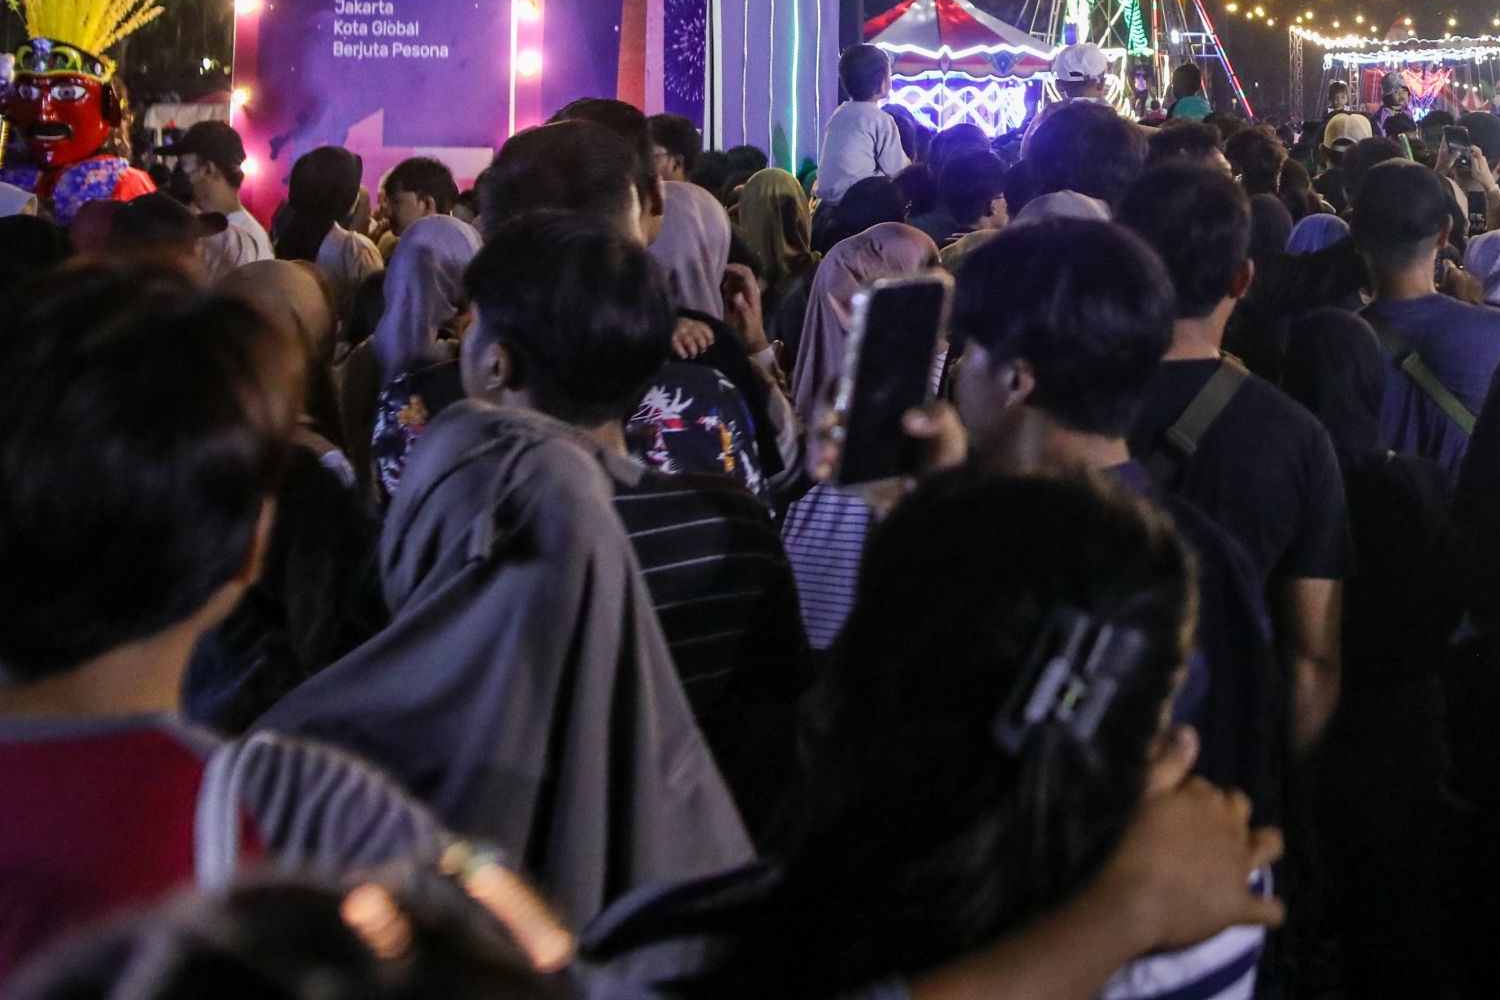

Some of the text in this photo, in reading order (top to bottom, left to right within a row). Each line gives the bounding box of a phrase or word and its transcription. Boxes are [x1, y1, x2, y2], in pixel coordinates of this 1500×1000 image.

[333, 20, 420, 37] Kota Global
[333, 41, 449, 60] Berjuta Pesona
